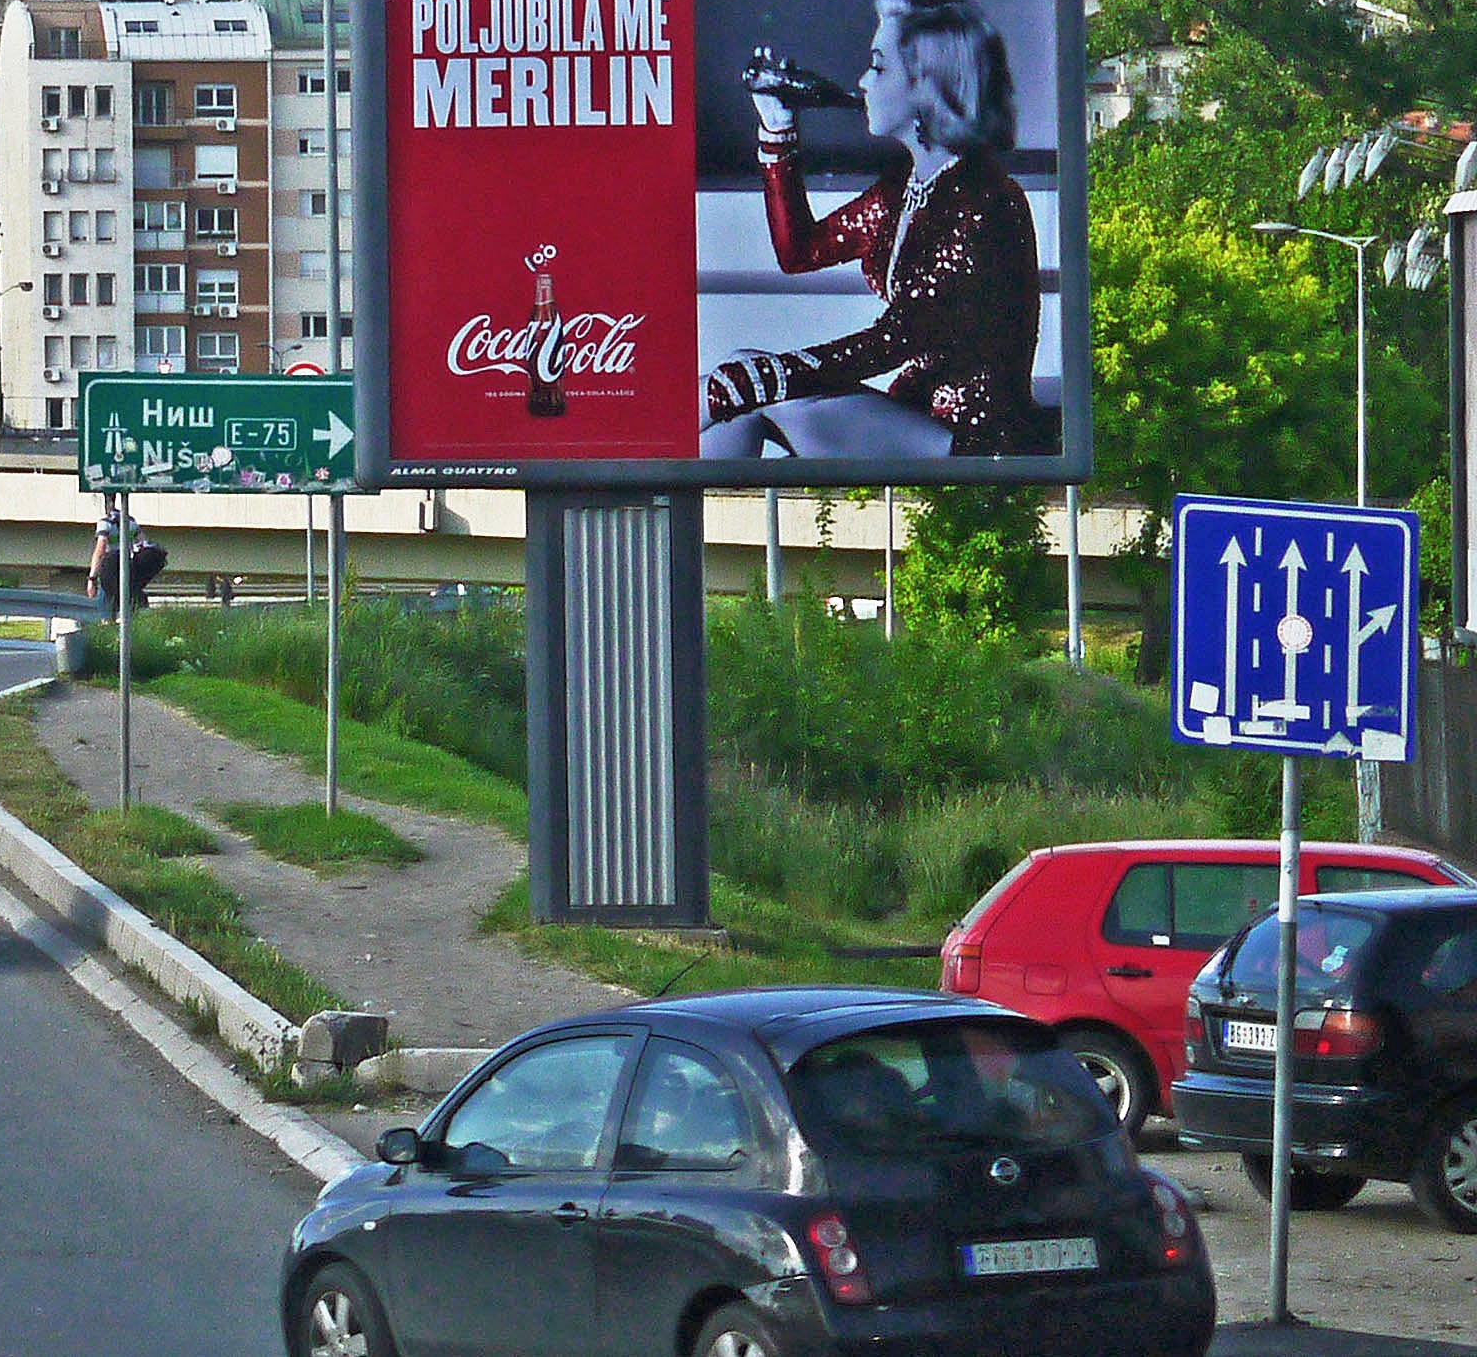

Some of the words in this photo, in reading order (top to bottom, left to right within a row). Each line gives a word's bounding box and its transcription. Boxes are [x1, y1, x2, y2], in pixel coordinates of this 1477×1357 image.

[413, 55, 674, 129] MERILIN
[142, 398, 215, 428] Ниш
[231, 422, 291, 446] E-75
[142, 441, 193, 470] Niš
[442, 467, 518, 475] QUATTRO
